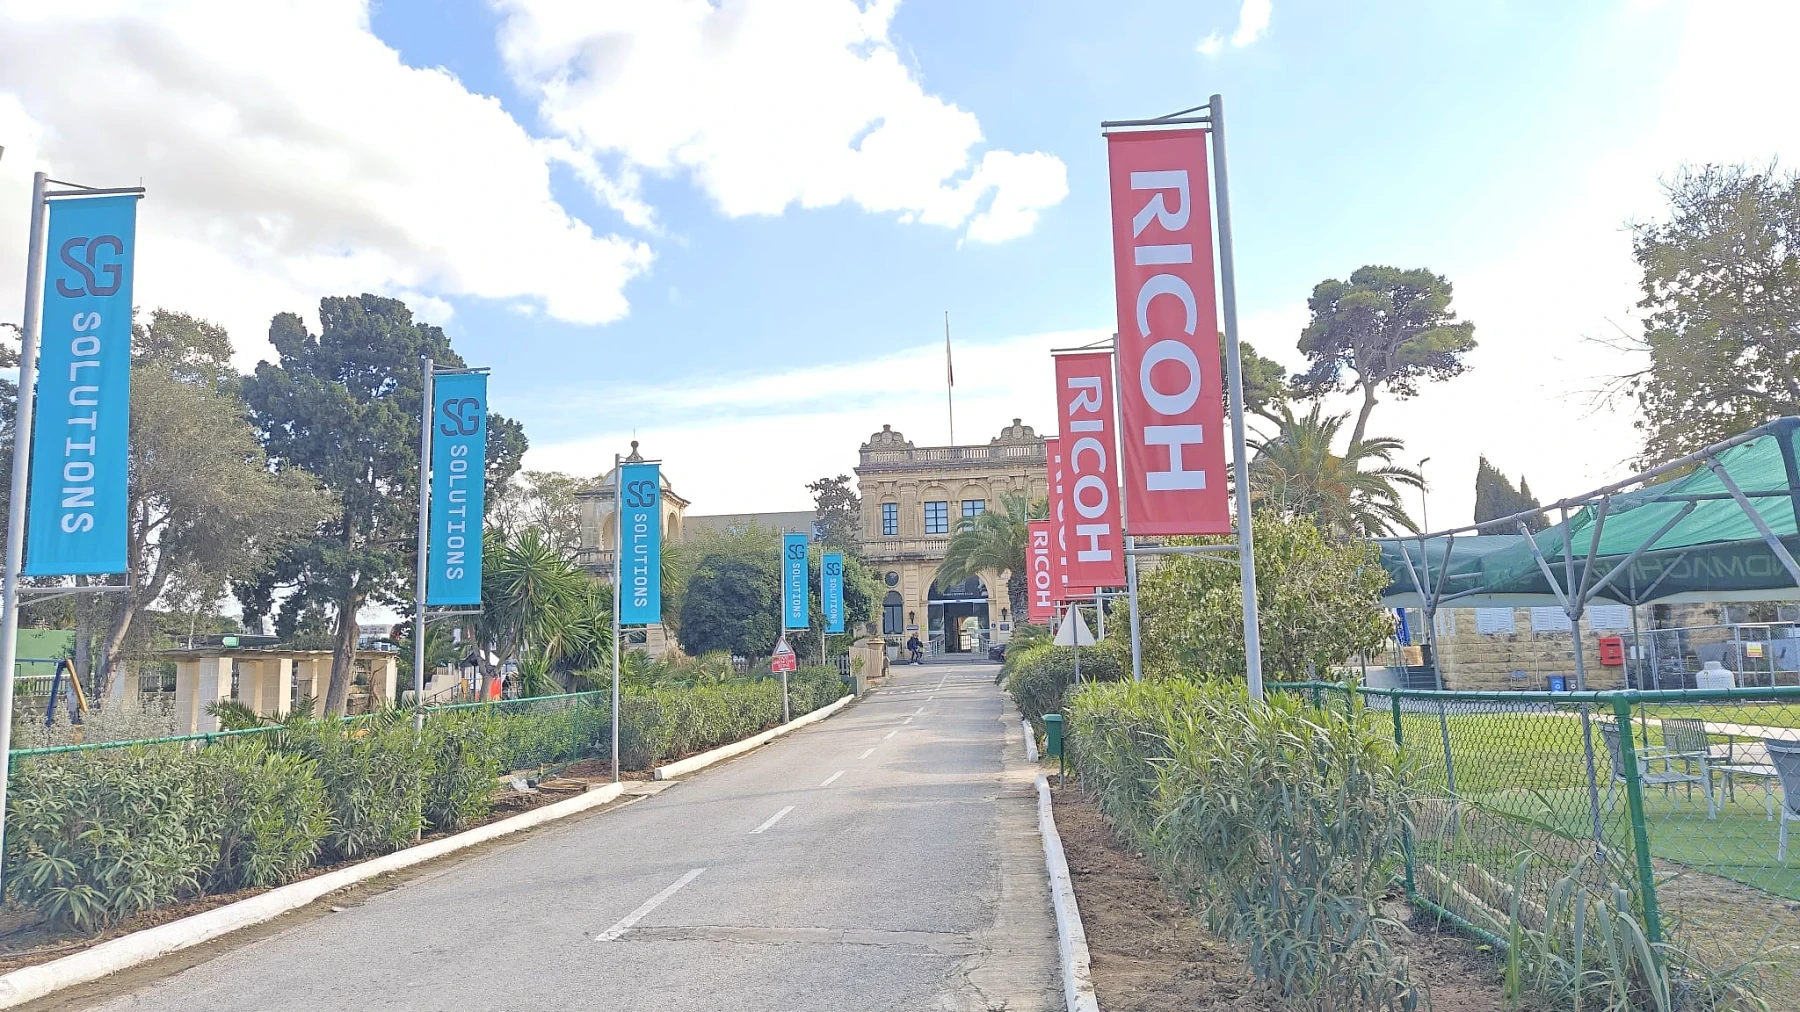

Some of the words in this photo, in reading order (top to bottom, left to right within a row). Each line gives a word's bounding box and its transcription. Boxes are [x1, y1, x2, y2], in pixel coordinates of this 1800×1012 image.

[55, 234, 125, 298] SG
[1130, 169, 1207, 491] RICOH
[61, 311, 102, 534] SOLUTIONS
[440, 397, 480, 437] SG
[626, 480, 656, 508] SG
[1067, 376, 1112, 562] RICOH
[446, 444, 468, 580] SOLUTIONS
[634, 513, 648, 608] SOLUTIONS
[788, 544, 805, 560] SG
[1033, 530, 1051, 607] RICOH
[792, 563, 801, 619] SOLUTIONS
[829, 578, 838, 625] SOLUTIONS
